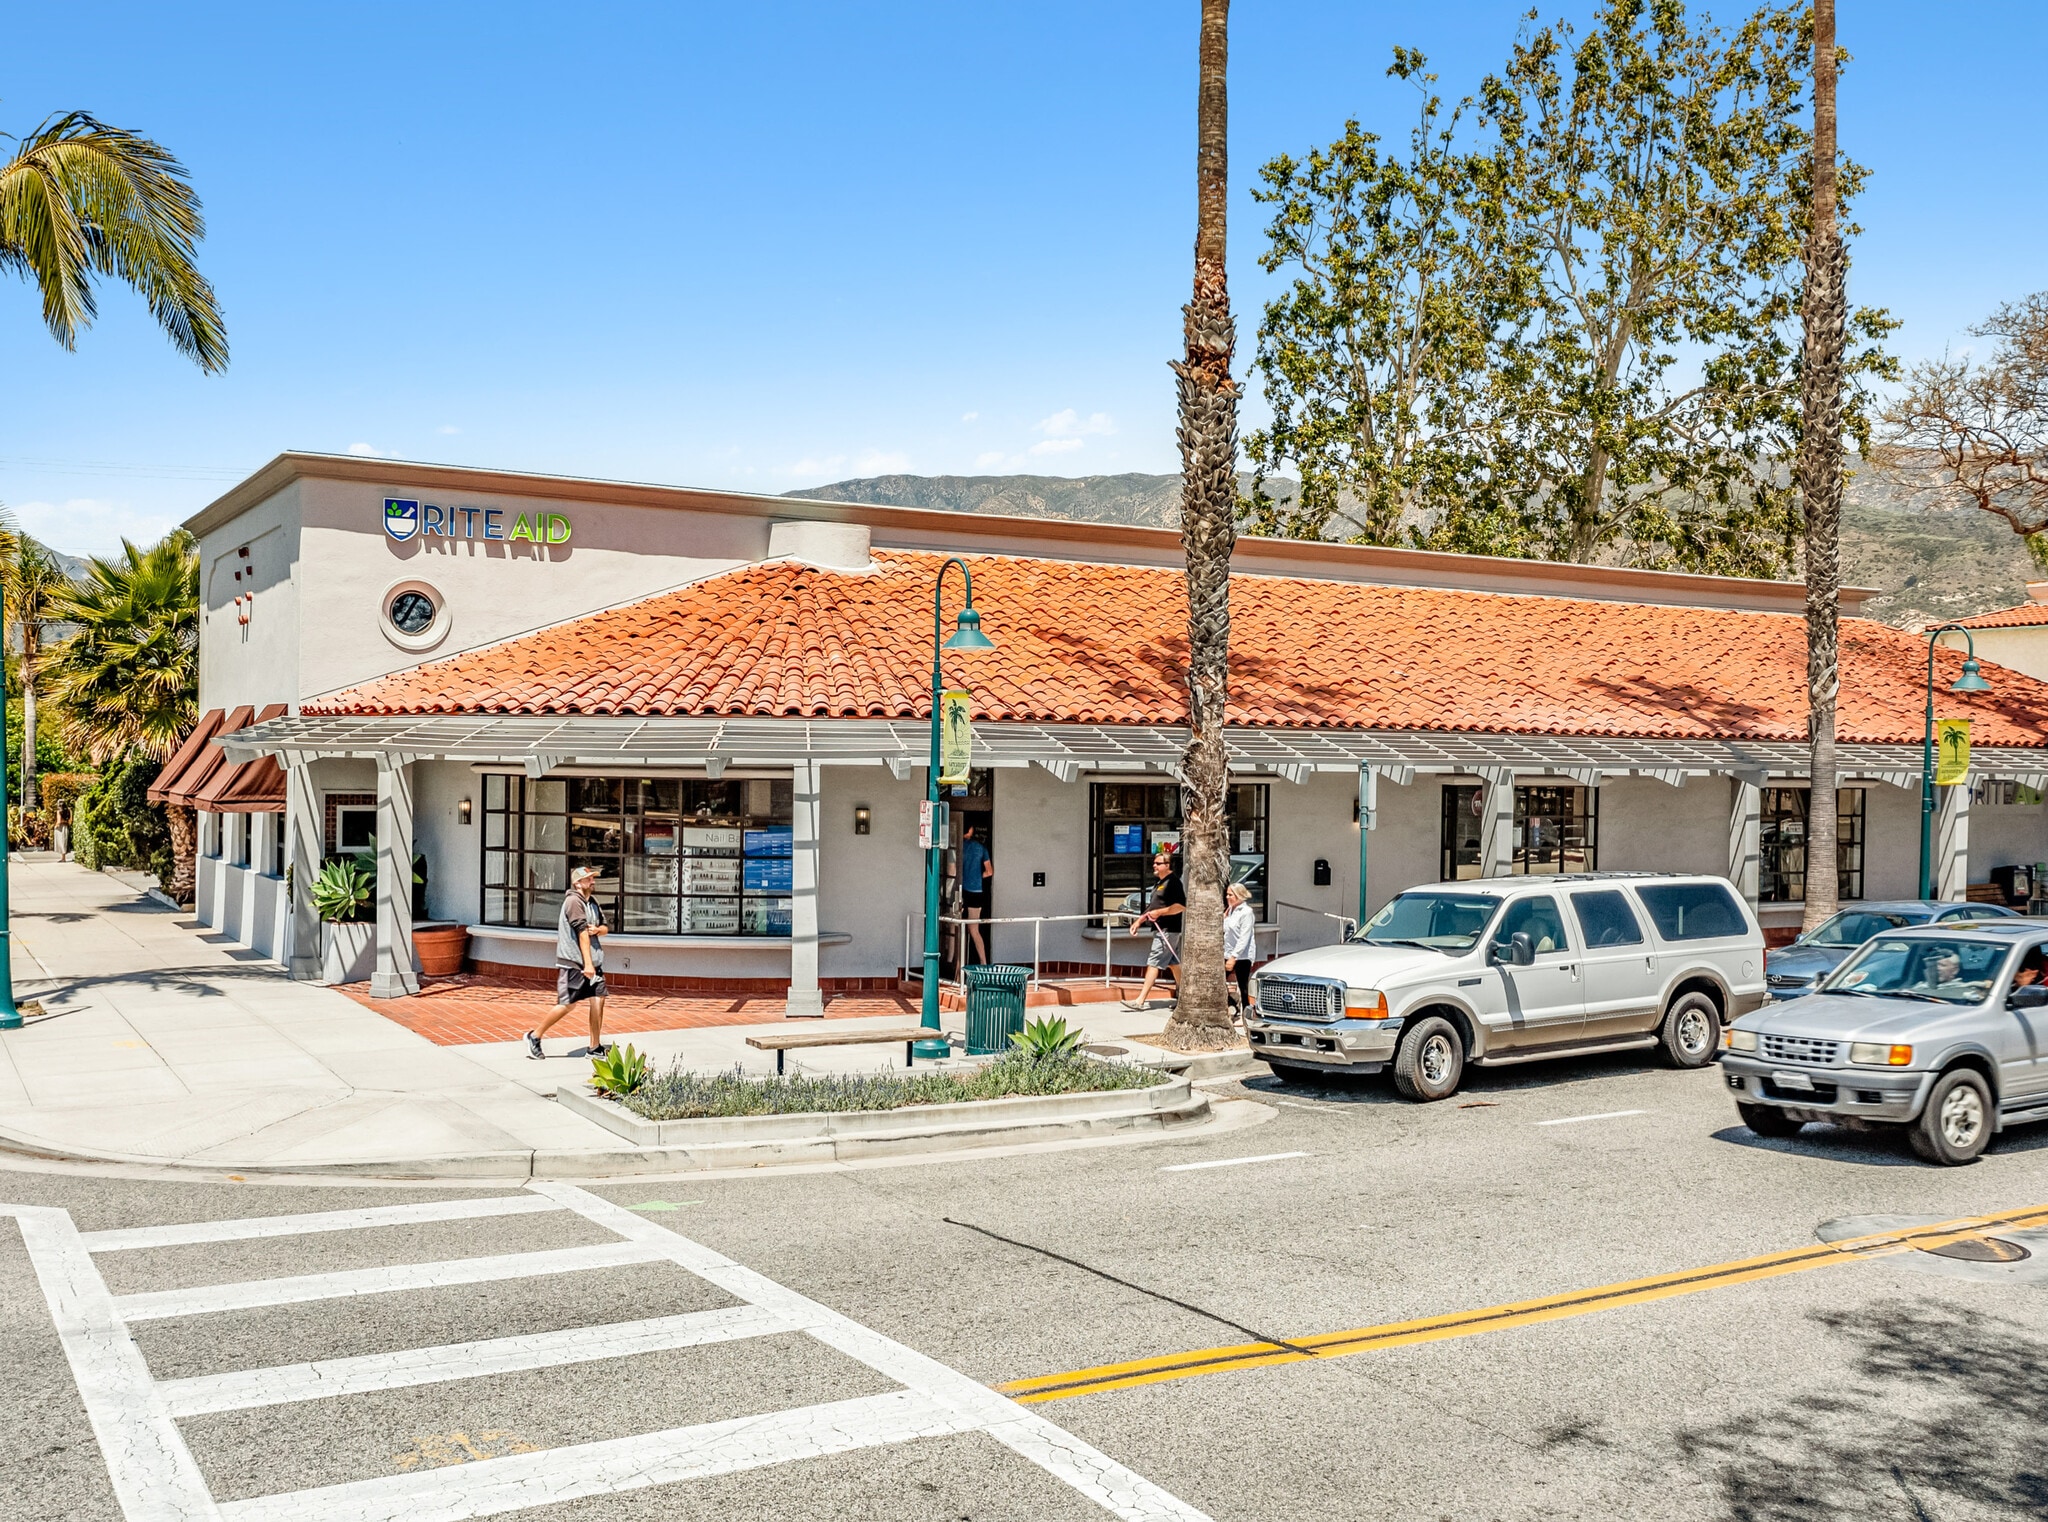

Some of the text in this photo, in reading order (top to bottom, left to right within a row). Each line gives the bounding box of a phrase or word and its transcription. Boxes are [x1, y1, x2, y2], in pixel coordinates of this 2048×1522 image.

[423, 504, 572, 544] RITE AID
[705, 833, 740, 843] Nail Ba
